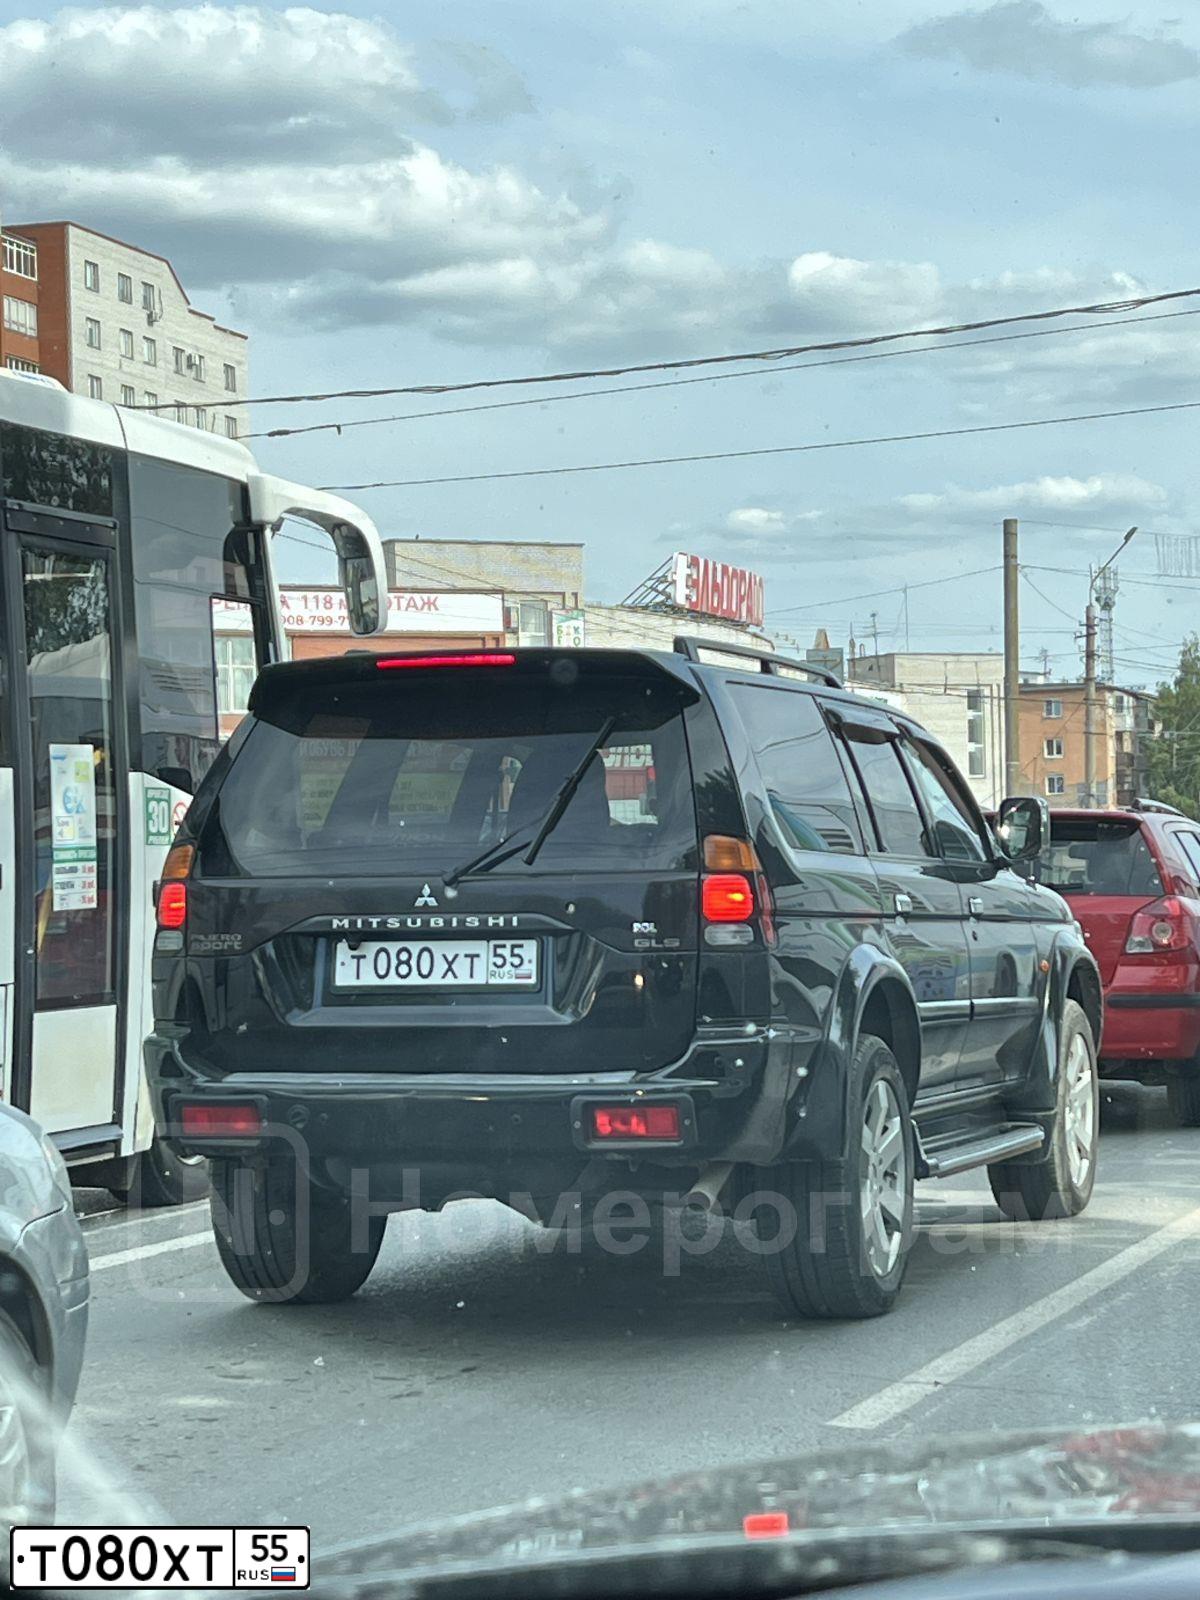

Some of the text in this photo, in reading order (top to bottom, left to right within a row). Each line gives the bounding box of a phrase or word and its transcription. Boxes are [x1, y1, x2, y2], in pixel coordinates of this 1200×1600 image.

[301, 594, 333, 610] 118
[147, 801, 169, 834] 30
[331, 916, 520, 930] MITSUBISHI
[634, 938, 680, 948] GLS
[492, 943, 526, 969] 55
[489, 970, 515, 980] RUS
